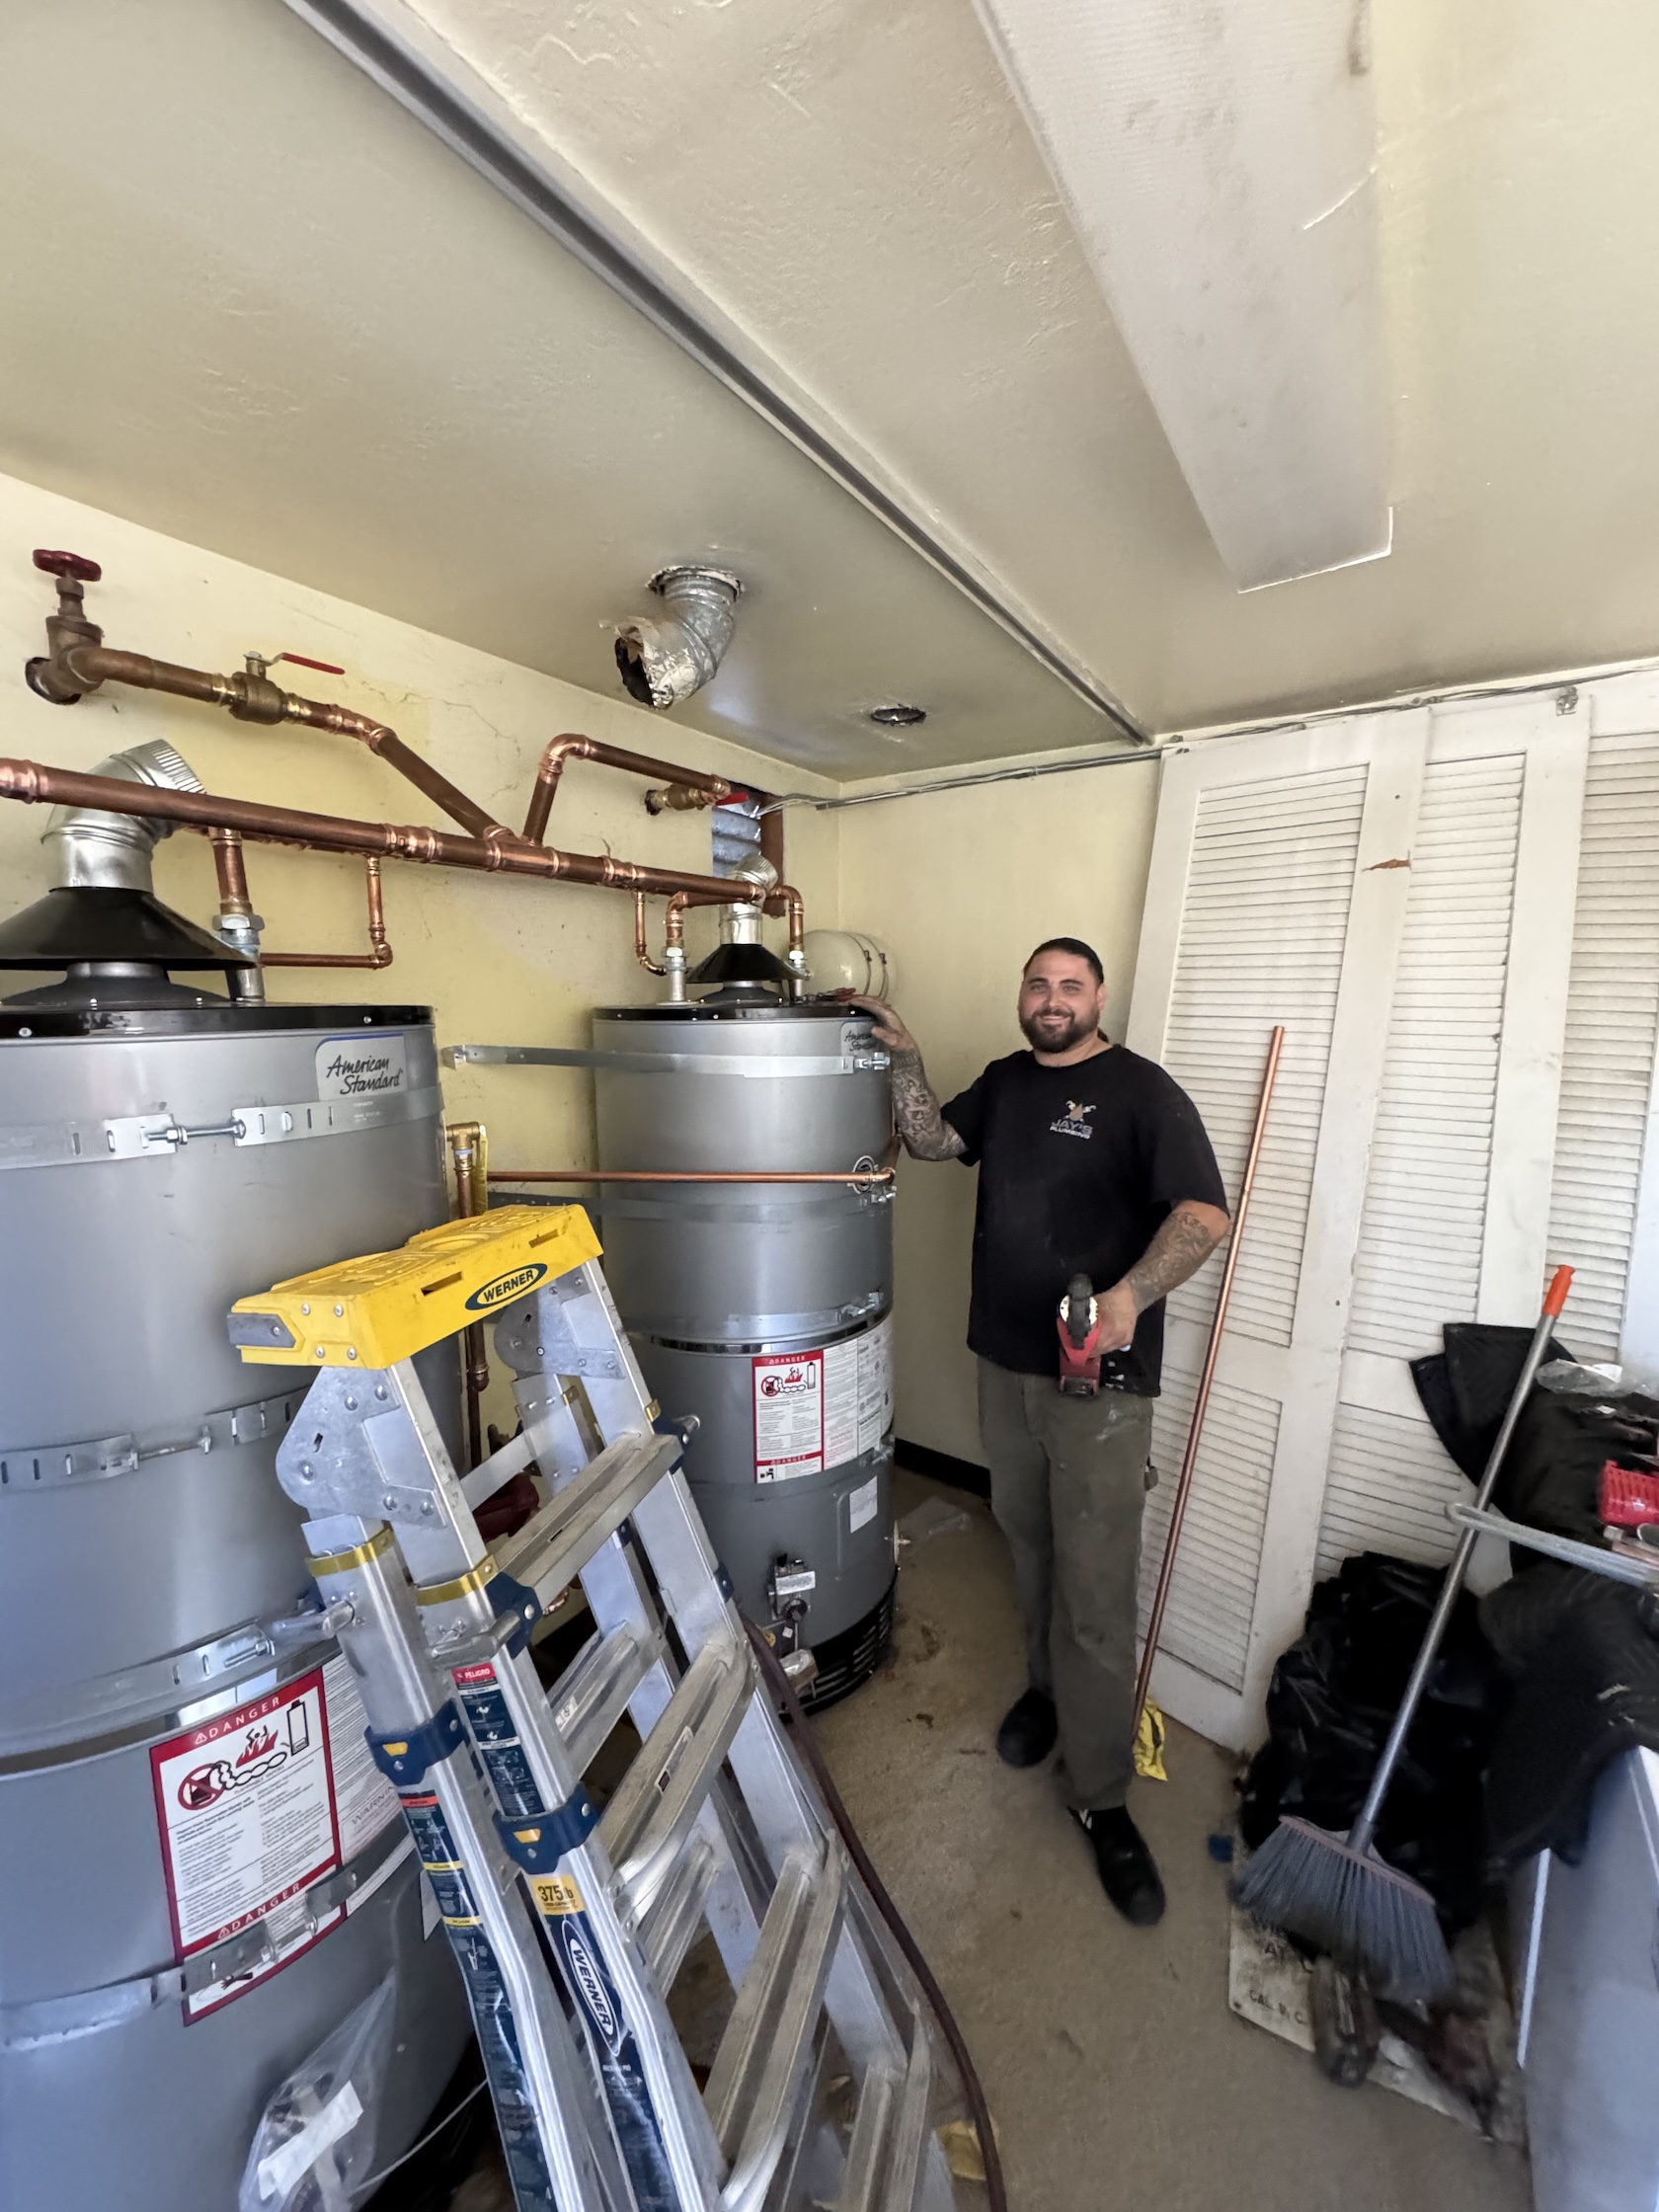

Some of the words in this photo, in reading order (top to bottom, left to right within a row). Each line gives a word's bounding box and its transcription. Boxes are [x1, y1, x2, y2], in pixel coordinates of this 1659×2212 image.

[326, 1054, 390, 1078] American
[340, 1069, 400, 1095] Standard
[483, 1269, 534, 1303] WERNER
[208, 1697, 279, 1739] DANGER
[352, 1785, 395, 1826] WARNIN
[231, 1882, 300, 1932] DANGER
[573, 1948, 611, 2026] WERNER
